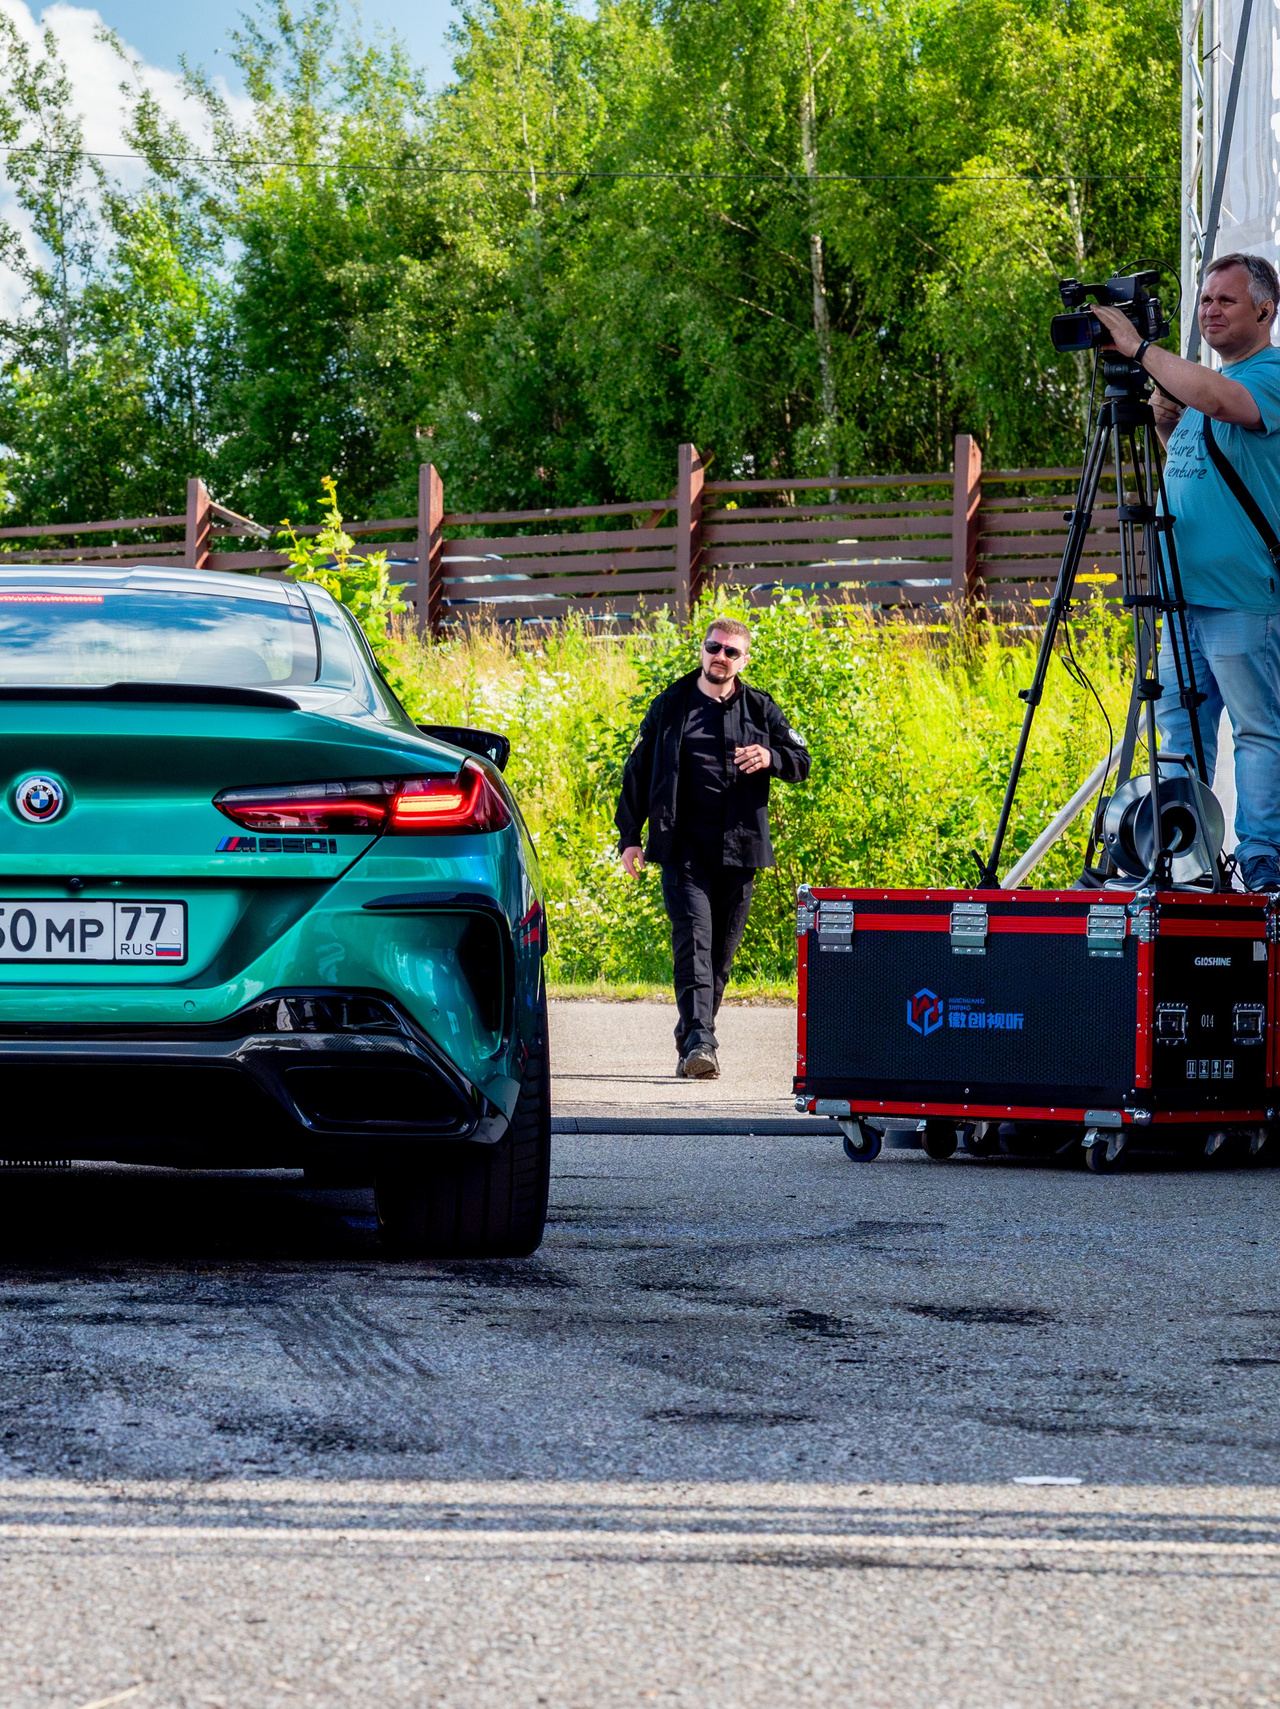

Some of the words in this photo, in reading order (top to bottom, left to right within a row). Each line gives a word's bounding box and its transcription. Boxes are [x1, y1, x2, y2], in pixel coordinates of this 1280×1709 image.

[28, 784, 53, 796] BMW
[120, 906, 167, 942] 77
[120, 943, 154, 956] RUS
[1200, 1014, 1214, 1028] 014
